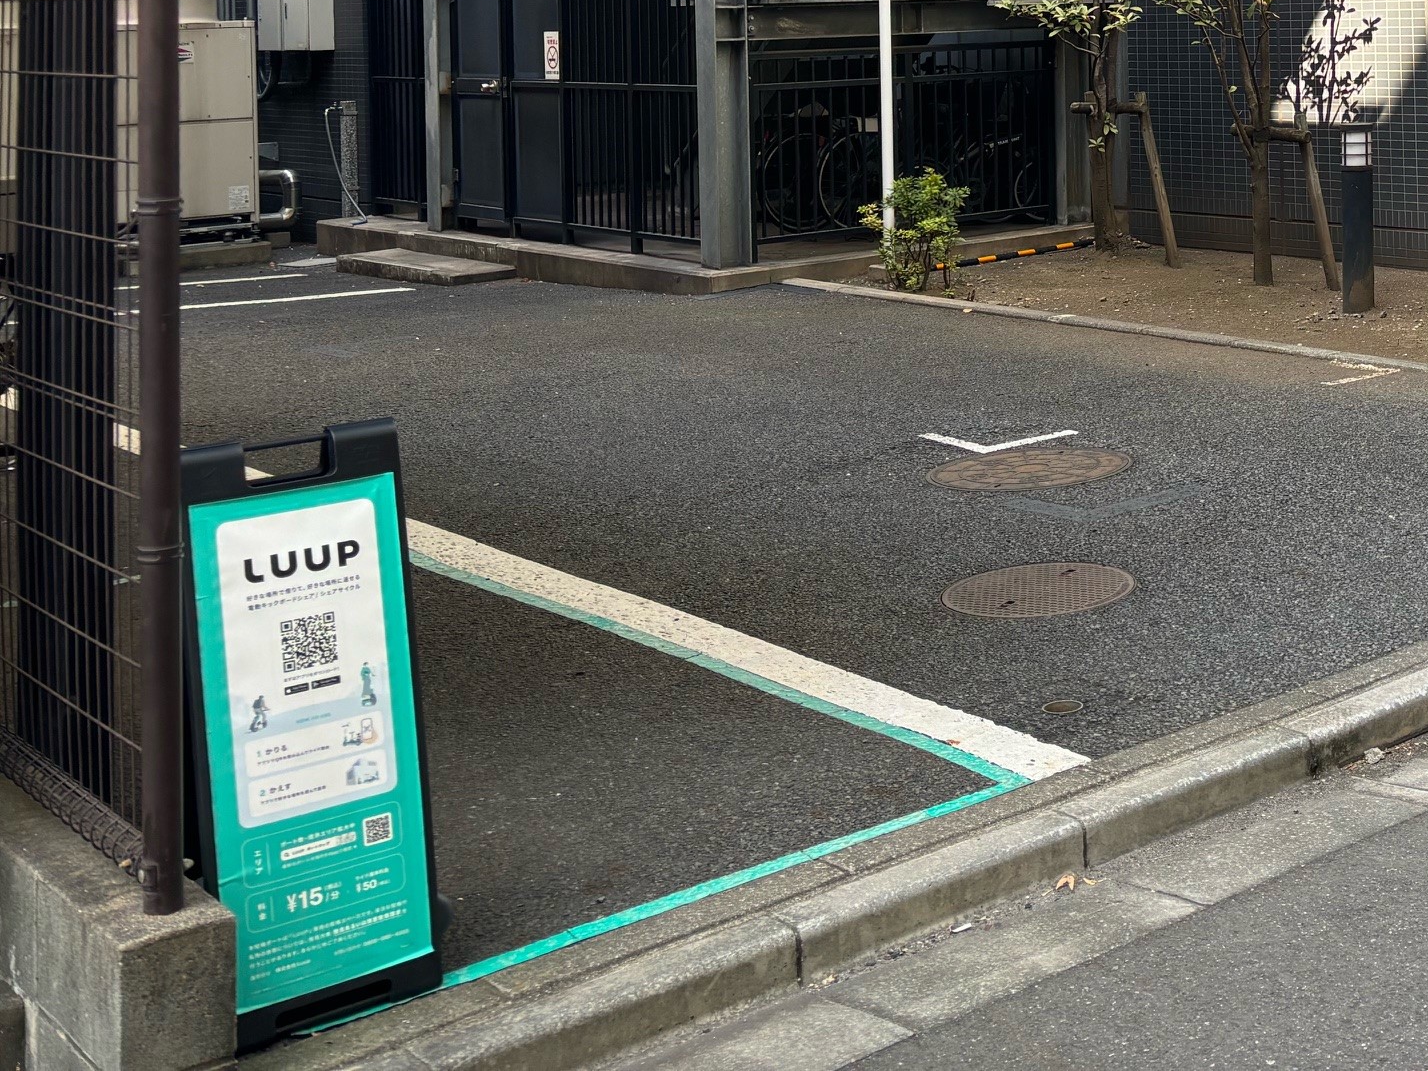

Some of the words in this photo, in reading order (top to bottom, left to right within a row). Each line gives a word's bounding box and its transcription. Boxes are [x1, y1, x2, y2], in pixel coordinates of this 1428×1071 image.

[243, 539, 361, 584] LUUP
[265, 744, 288, 756] かりる
[269, 783, 291, 795] かえす
[286, 886, 324, 913] ¥15
